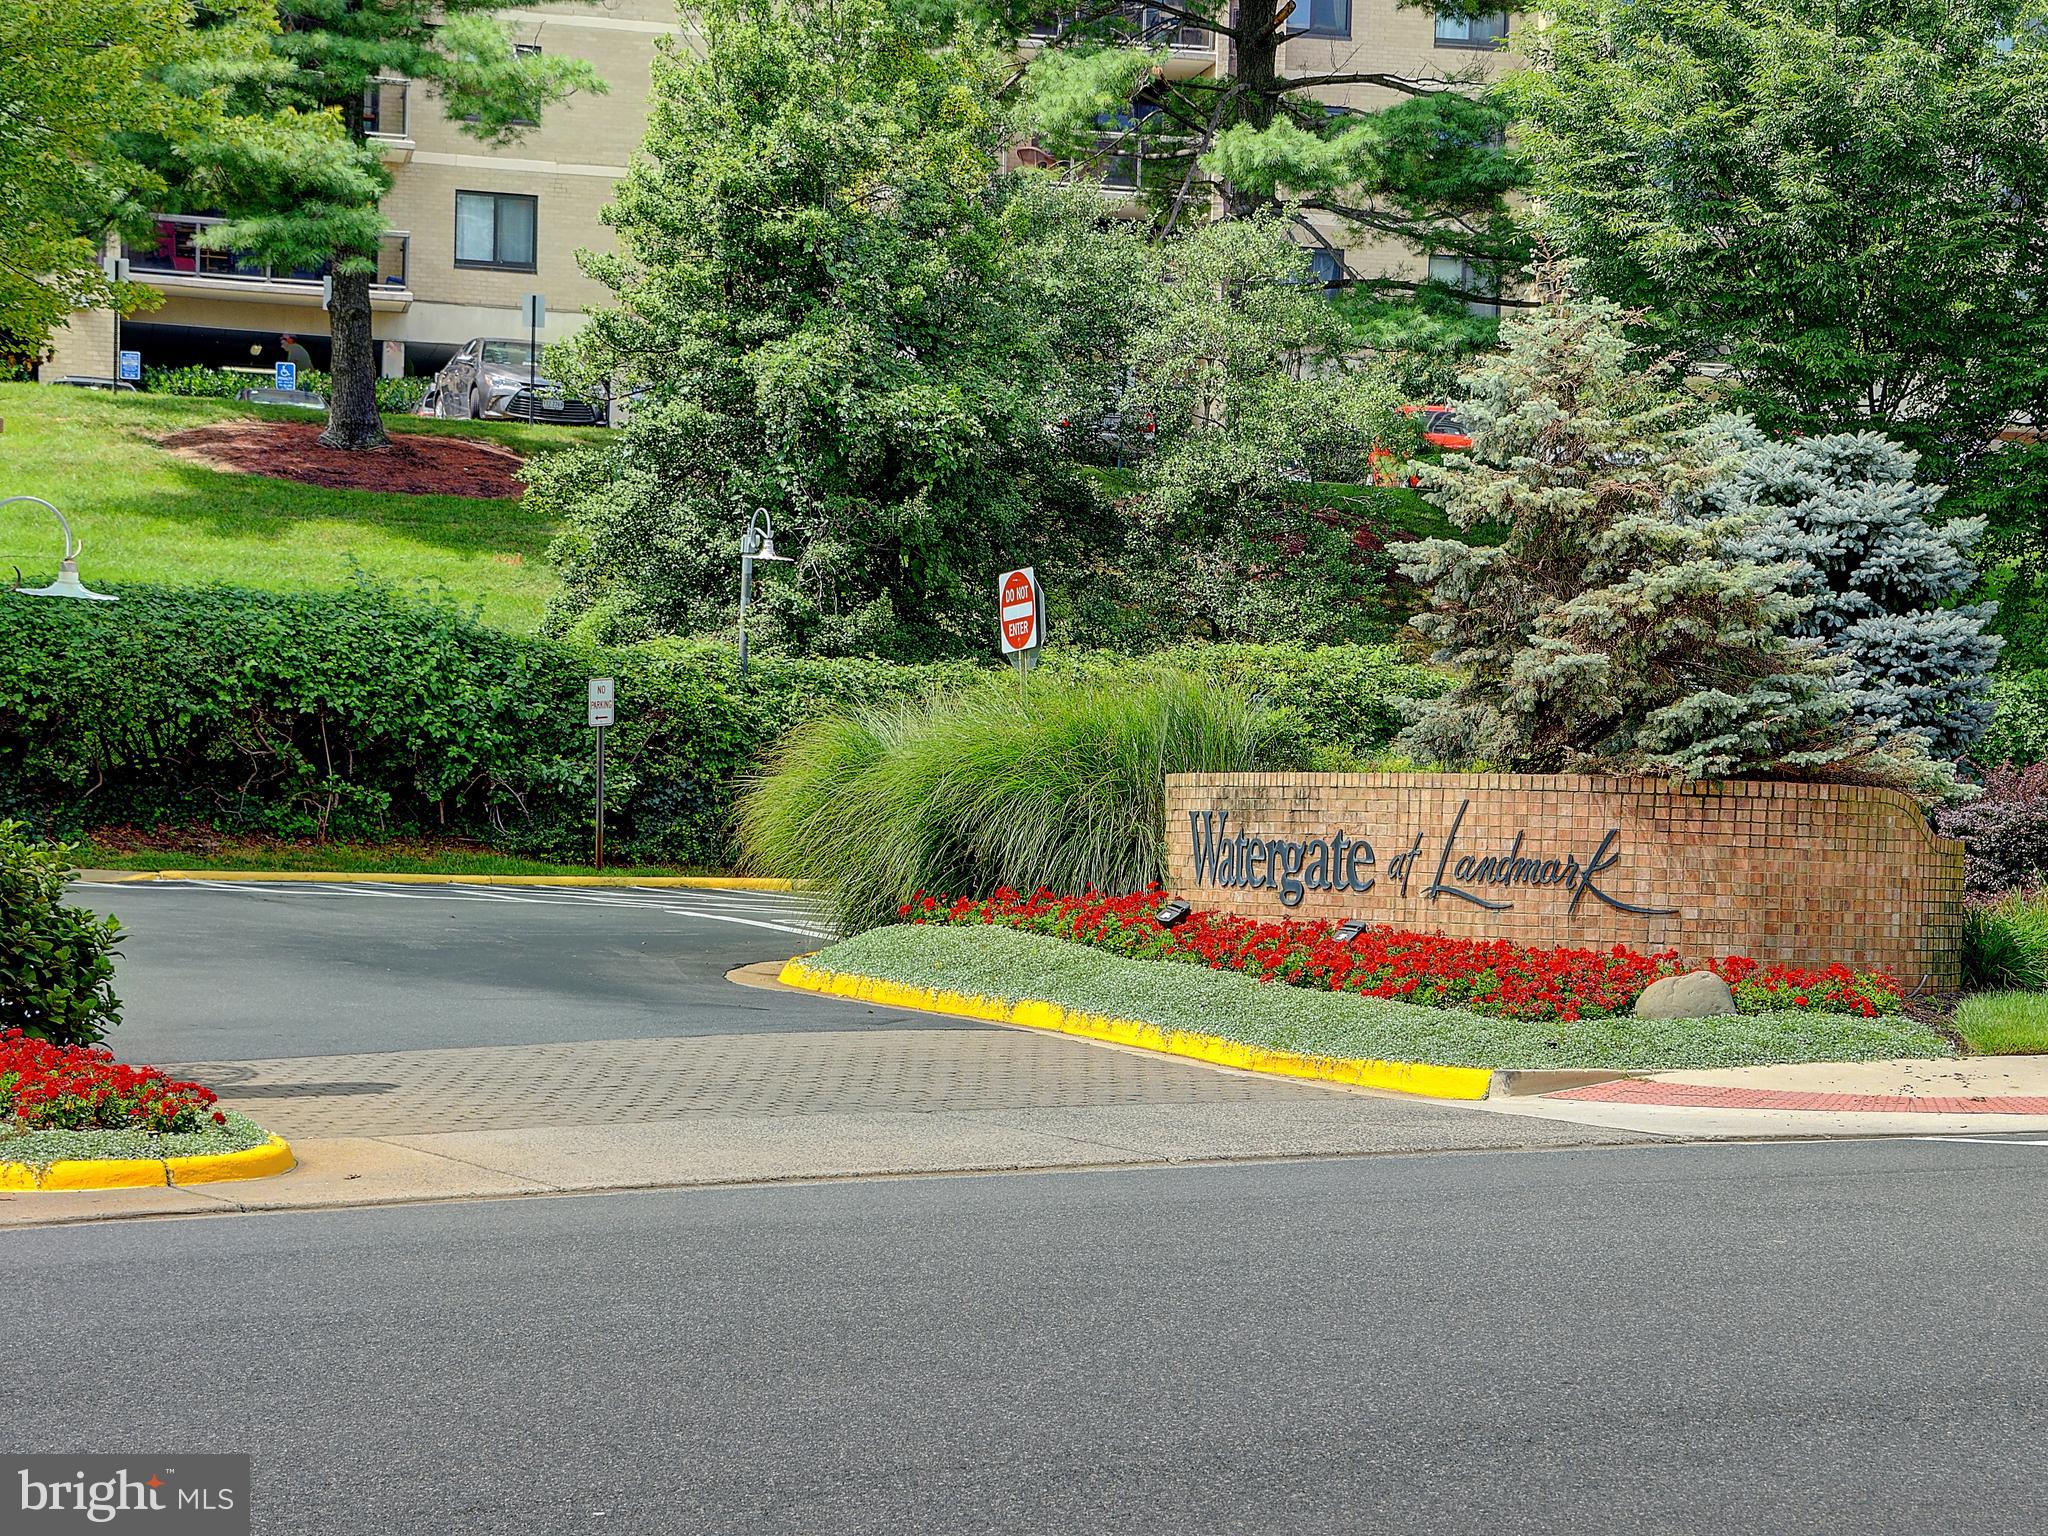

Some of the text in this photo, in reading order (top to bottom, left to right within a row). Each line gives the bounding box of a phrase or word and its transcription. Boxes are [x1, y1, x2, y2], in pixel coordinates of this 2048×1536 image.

[1005, 585, 1029, 603] DO NOT
[1008, 620, 1029, 637] ENTER
[597, 685, 606, 695] NO
[591, 700, 613, 709] PARKING
[1188, 799, 1680, 915] Watergate at Landmark
